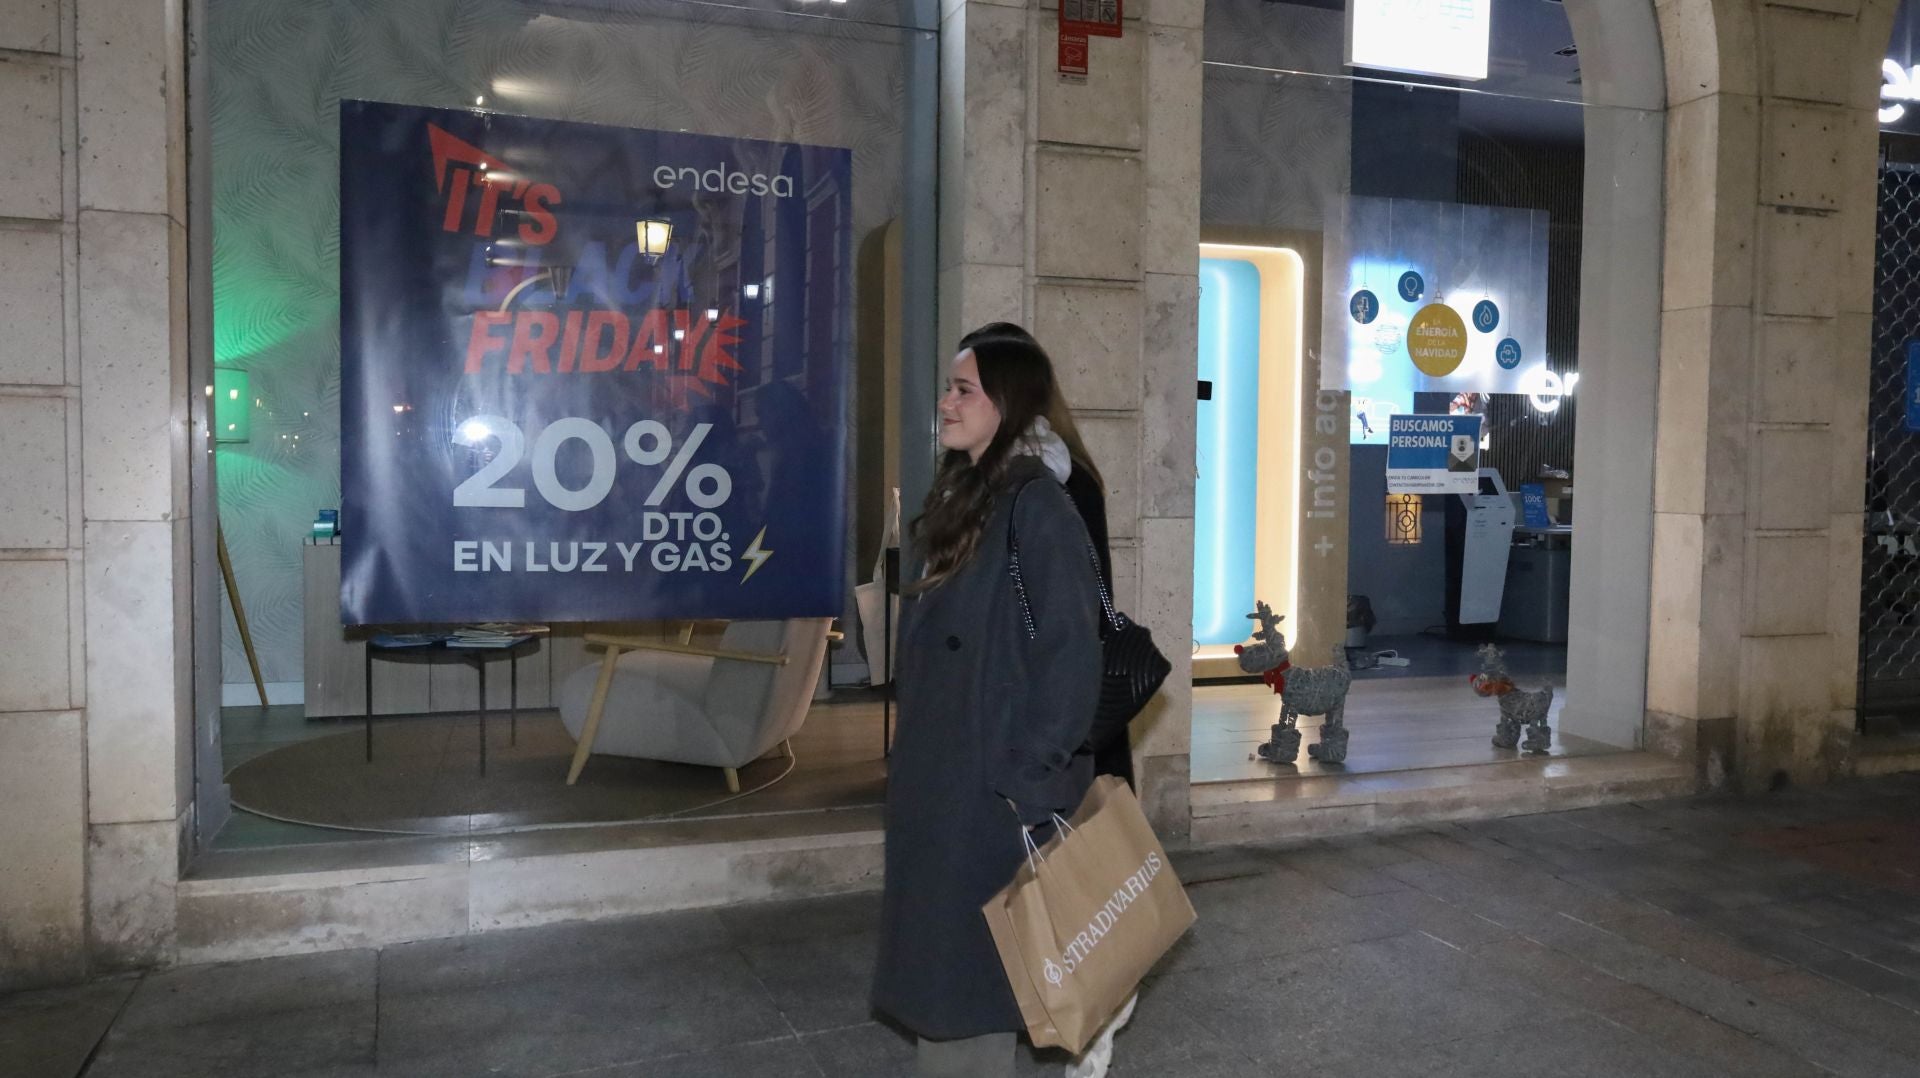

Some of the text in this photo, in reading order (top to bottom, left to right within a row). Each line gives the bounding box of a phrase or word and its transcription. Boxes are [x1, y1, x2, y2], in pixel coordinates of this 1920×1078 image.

[653, 162, 793, 198] endesa
[442, 168, 561, 245] IT'S
[462, 240, 702, 305] BLACK
[463, 309, 712, 375] FRIDAY
[1416, 347, 1458, 359] NAVIDAD
[1391, 435, 1448, 448] PERSONAL
[1392, 419, 1454, 433] BUSCAMOS
[452, 415, 732, 512] 20%
[1307, 446, 1336, 519] info
[643, 512, 730, 542] DTO.
[453, 541, 733, 573] EN LUZ Y GAS
[1062, 851, 1162, 975] STRADIVARIUS
